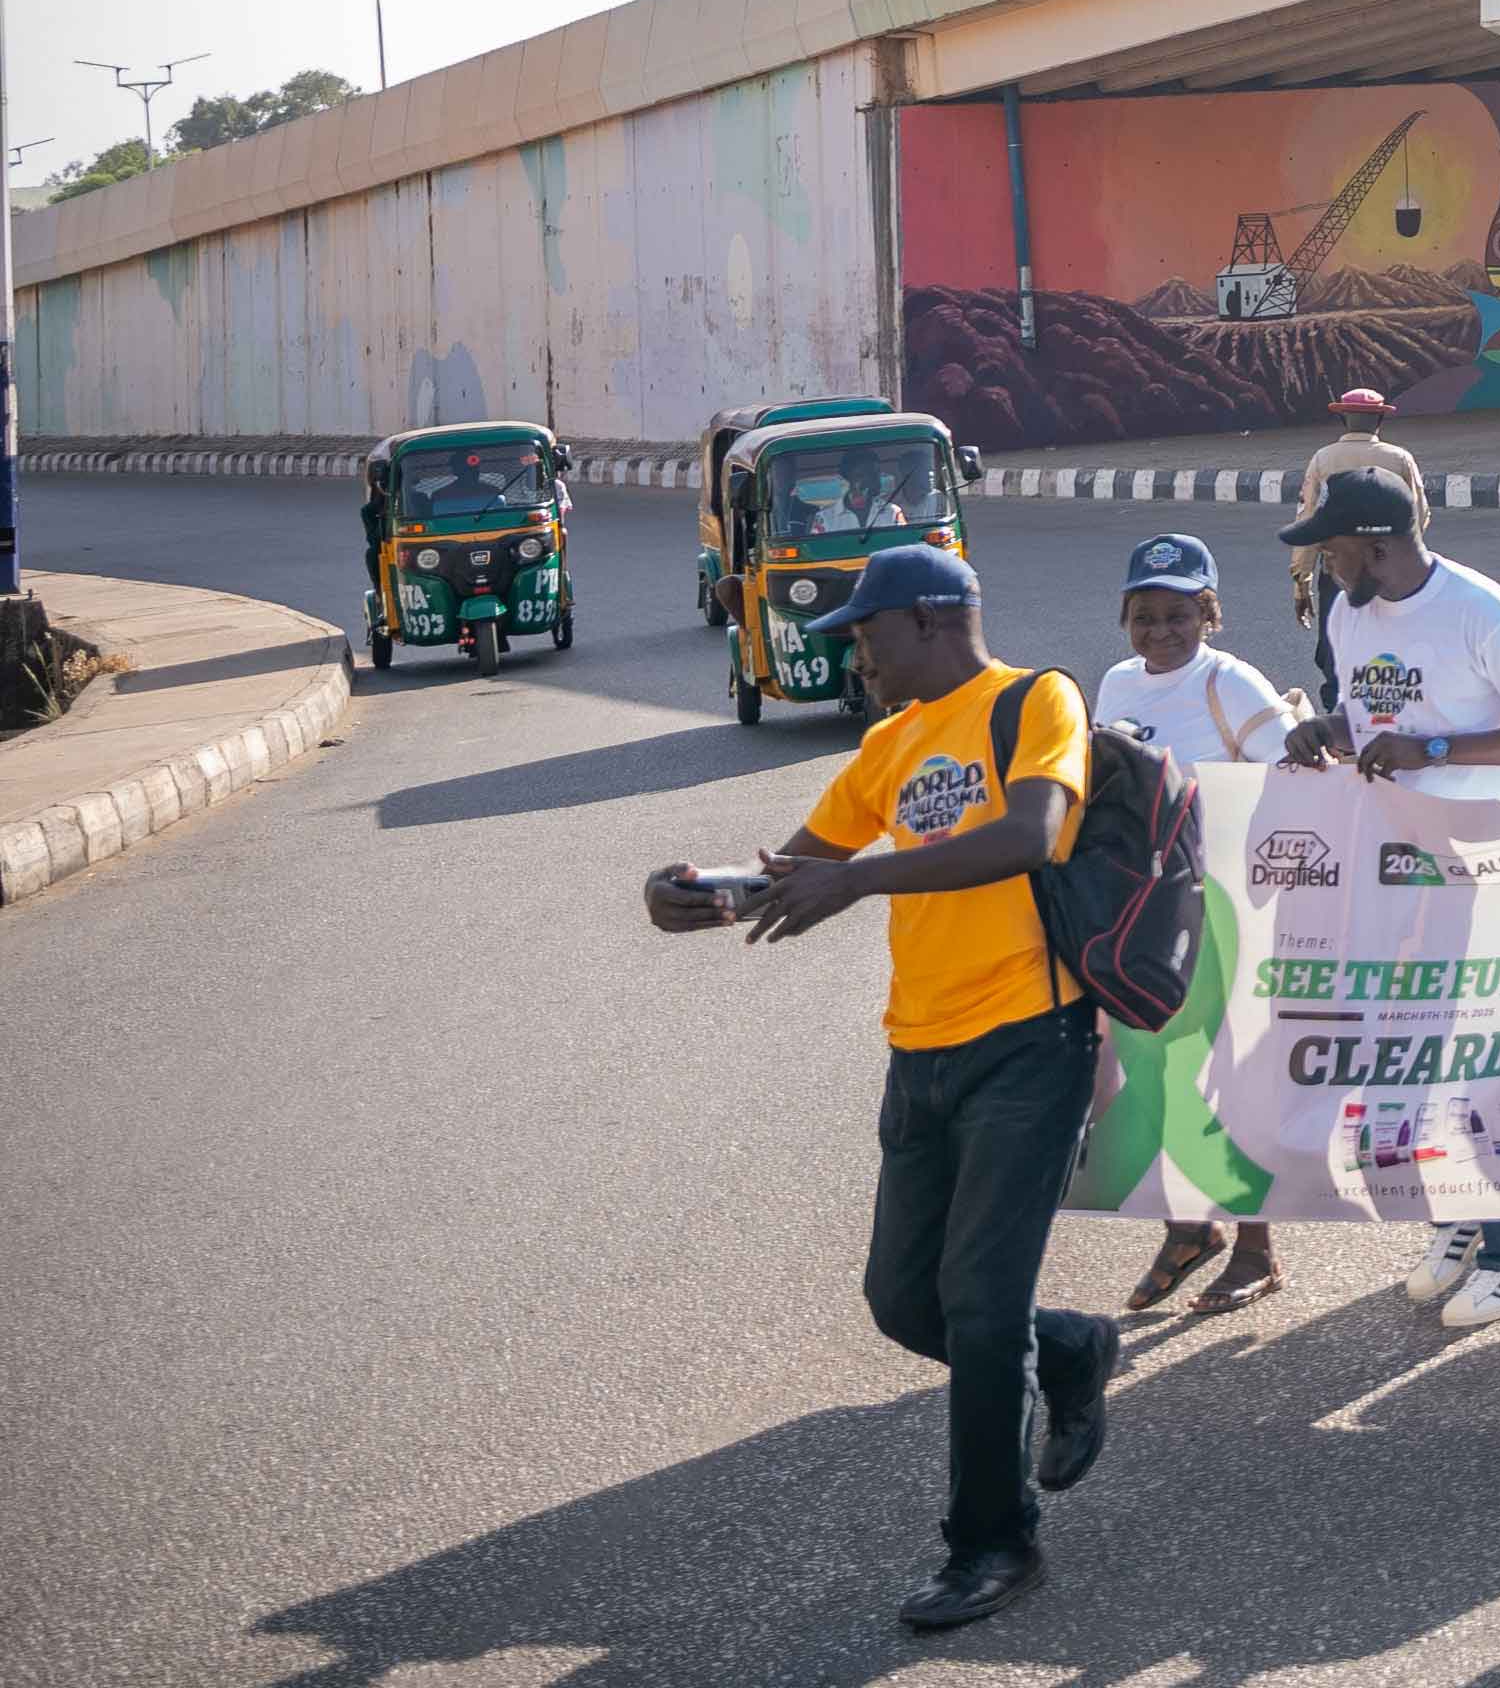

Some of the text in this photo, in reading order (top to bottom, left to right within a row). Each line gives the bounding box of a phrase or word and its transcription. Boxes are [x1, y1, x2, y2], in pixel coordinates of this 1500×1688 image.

[1351, 665, 1423, 687] WORLD
[1350, 685, 1424, 703] GLAUCOMA
[1368, 701, 1402, 713] WEEK
[898, 763, 985, 807] WORLD
[914, 812, 959, 833] WEEK
[1251, 860, 1340, 892] Drugfield
[1278, 932, 1336, 950] Theme:
[1252, 956, 1340, 1000] SEE
[1343, 959, 1450, 1002] THE
[1409, 1180, 1472, 1199] product
